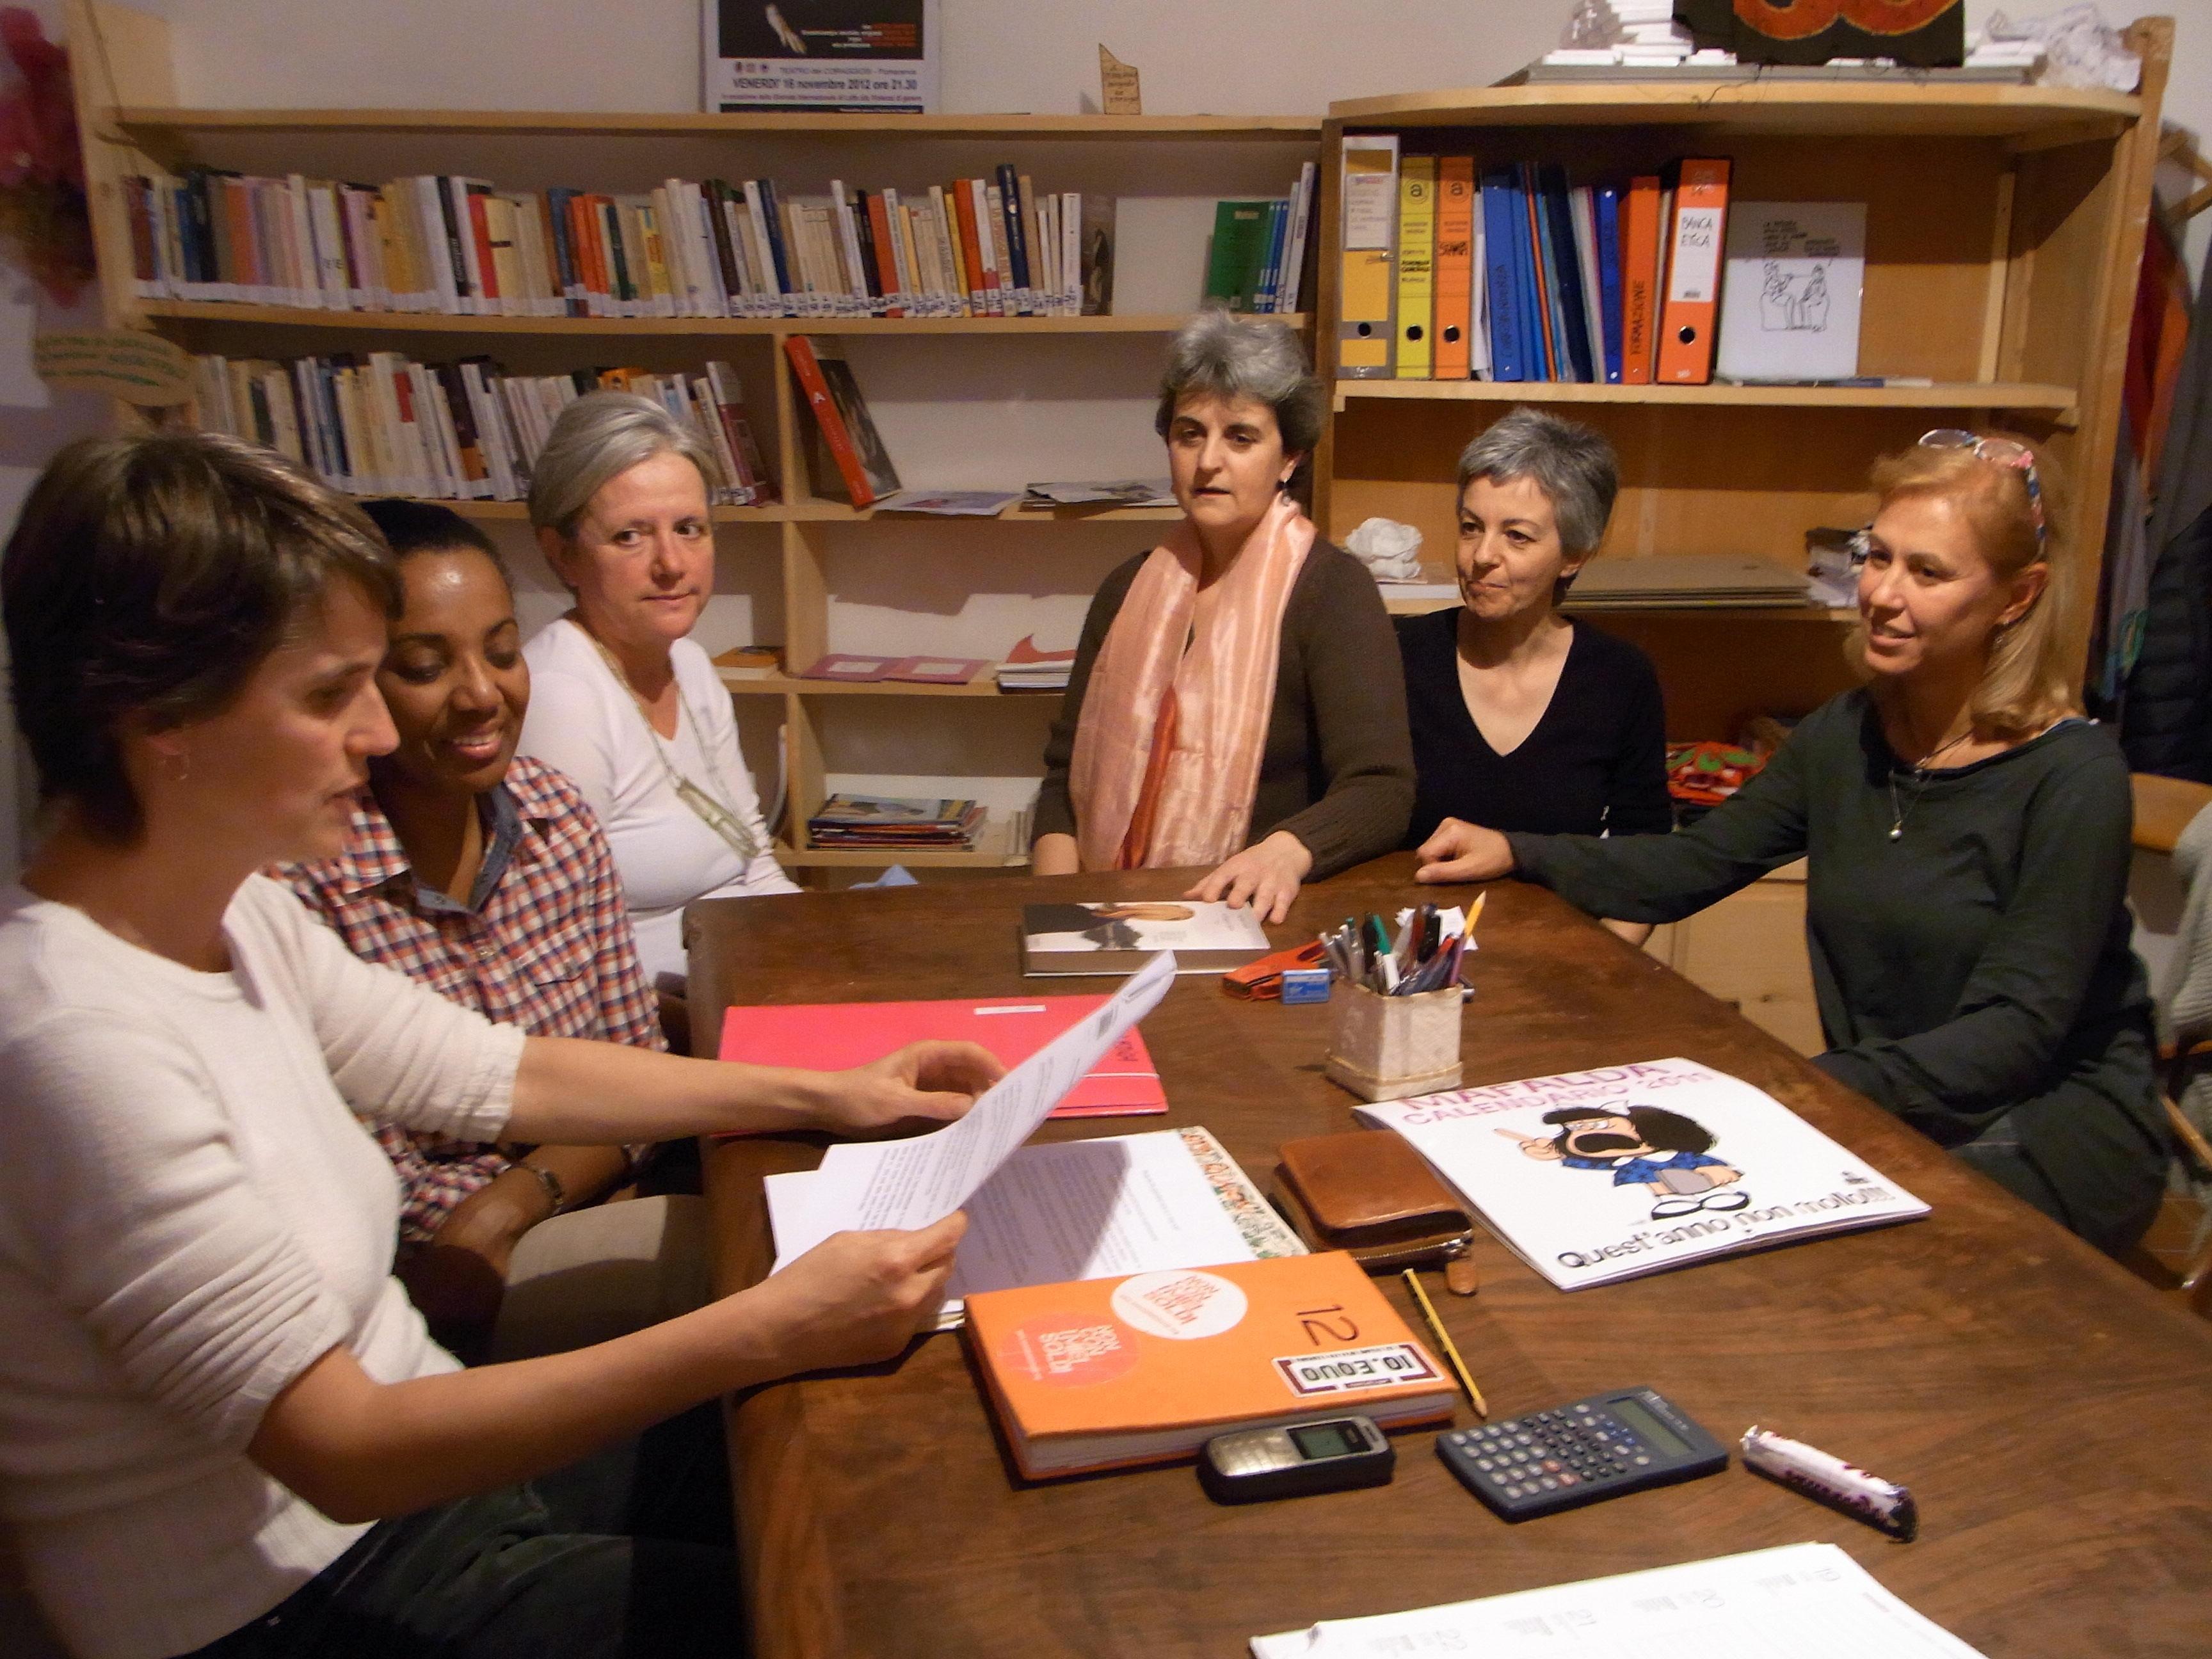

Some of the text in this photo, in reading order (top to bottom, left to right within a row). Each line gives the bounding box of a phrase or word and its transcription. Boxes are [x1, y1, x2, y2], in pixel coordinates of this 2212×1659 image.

[1681, 216, 1713, 230] BANCA
[1400, 1062, 1671, 1111] MAFALDA
[1402, 1083, 1630, 1125] CALENDARIO
[1557, 1214, 1731, 1269] Quest'anno
[1733, 1204, 1794, 1228] non
[1295, 1304, 1360, 1346] 12
